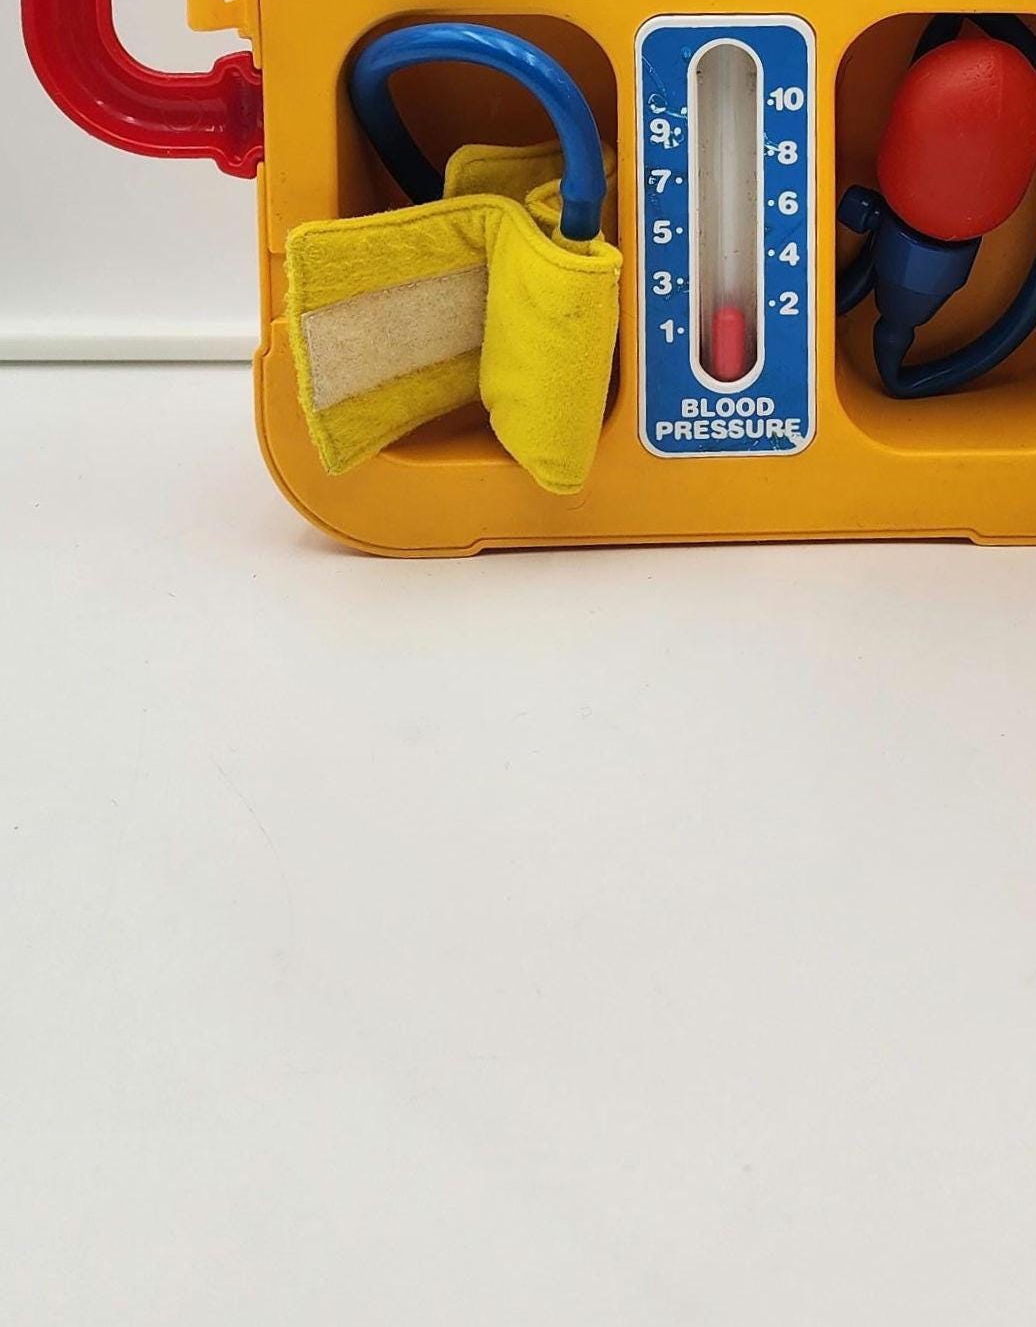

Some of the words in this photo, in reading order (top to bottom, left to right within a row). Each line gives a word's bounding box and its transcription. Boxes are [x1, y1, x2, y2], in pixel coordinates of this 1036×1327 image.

[769, 86, 805, 112] 10
[649, 118, 671, 146] 9
[777, 140, 799, 166] 8
[651, 169, 673, 194] 7
[777, 191, 799, 216] 6
[652, 220, 674, 245] 5
[778, 242, 801, 267] 4
[652, 271, 674, 295] 3
[779, 291, 800, 316] 2
[659, 318, 675, 344] 1
[680, 396, 775, 419] BLOOD
[655, 417, 803, 441] PRESSURE
